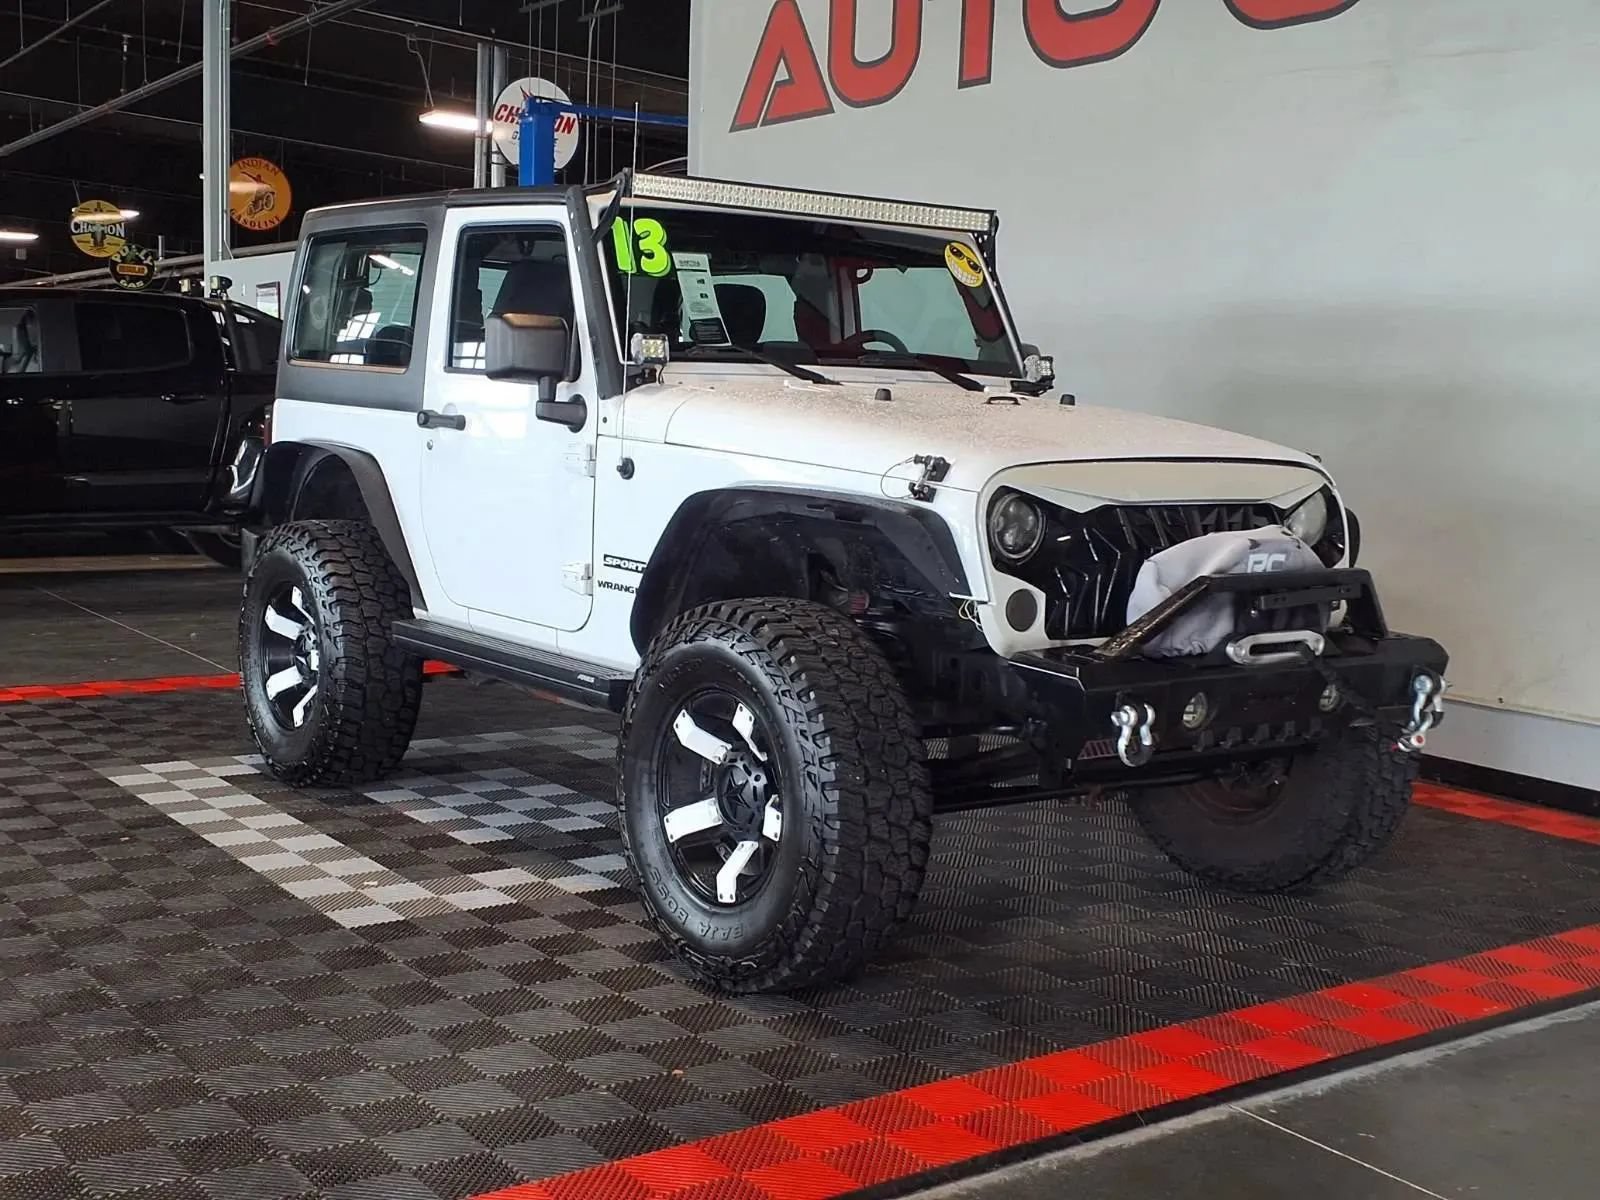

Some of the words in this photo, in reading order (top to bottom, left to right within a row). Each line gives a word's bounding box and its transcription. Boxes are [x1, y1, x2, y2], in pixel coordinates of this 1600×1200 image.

[238, 159, 280, 177] INDIAN
[70, 220, 126, 238] CHAION
[611, 216, 671, 277] 13
[120, 279, 144, 288] GAS
[604, 556, 647, 572] SPORT
[597, 579, 639, 594] WRANG
[648, 865, 689, 926] BOSS
[697, 921, 744, 940] BAJA
